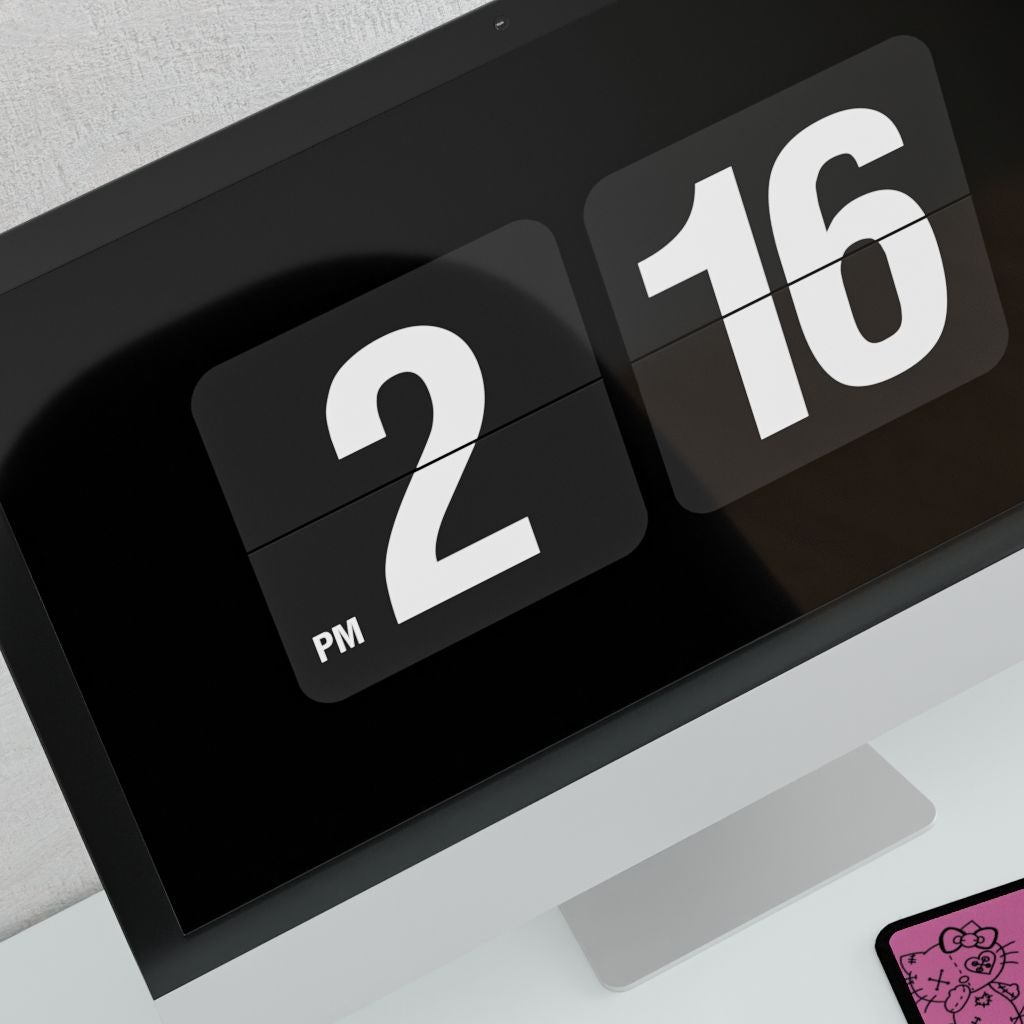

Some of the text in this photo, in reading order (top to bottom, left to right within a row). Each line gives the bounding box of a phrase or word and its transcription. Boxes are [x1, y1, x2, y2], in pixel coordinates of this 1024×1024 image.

[326, 108, 947, 625] 2 16
[311, 616, 365, 664] PM
